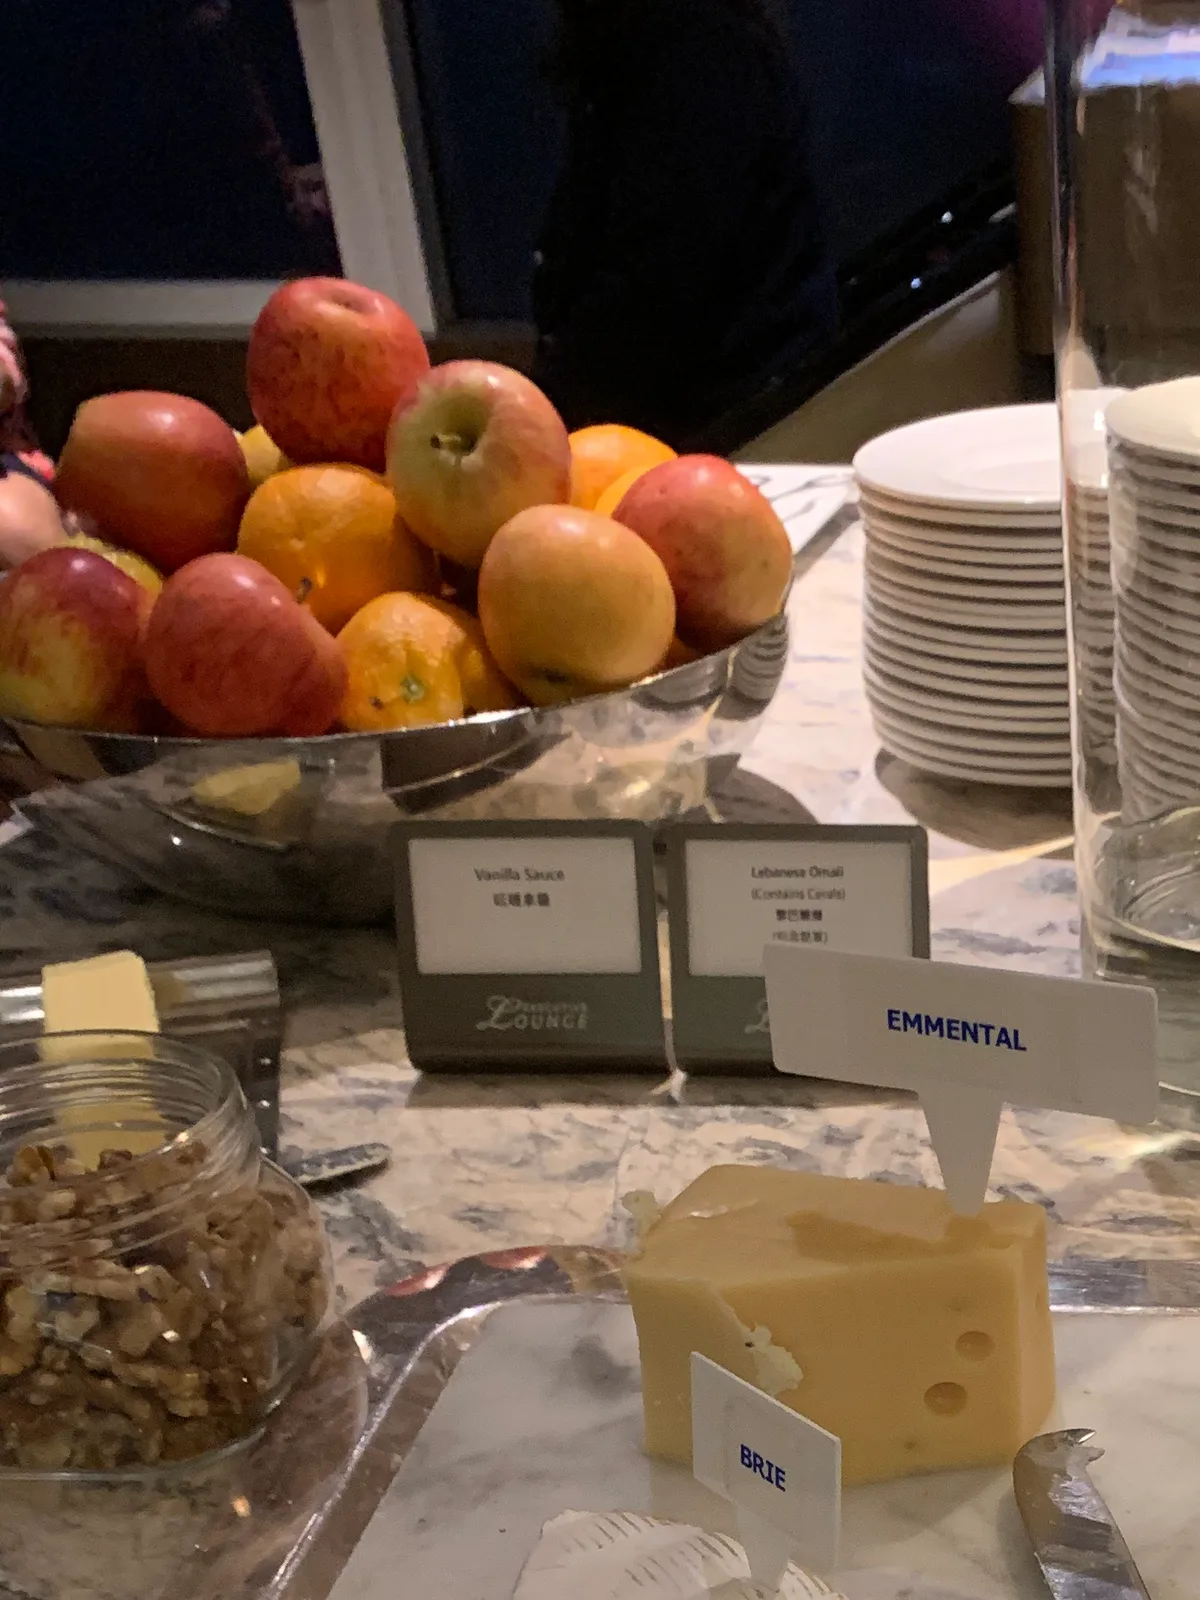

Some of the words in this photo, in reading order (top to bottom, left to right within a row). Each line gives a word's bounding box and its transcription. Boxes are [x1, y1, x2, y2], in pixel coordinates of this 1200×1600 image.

[473, 866, 520, 880] Vanilla
[524, 866, 564, 881] Sauce
[751, 866, 805, 878] Lebanese
[887, 1009, 1027, 1051] EMMENTAL
[740, 1443, 786, 1492] BRIE
